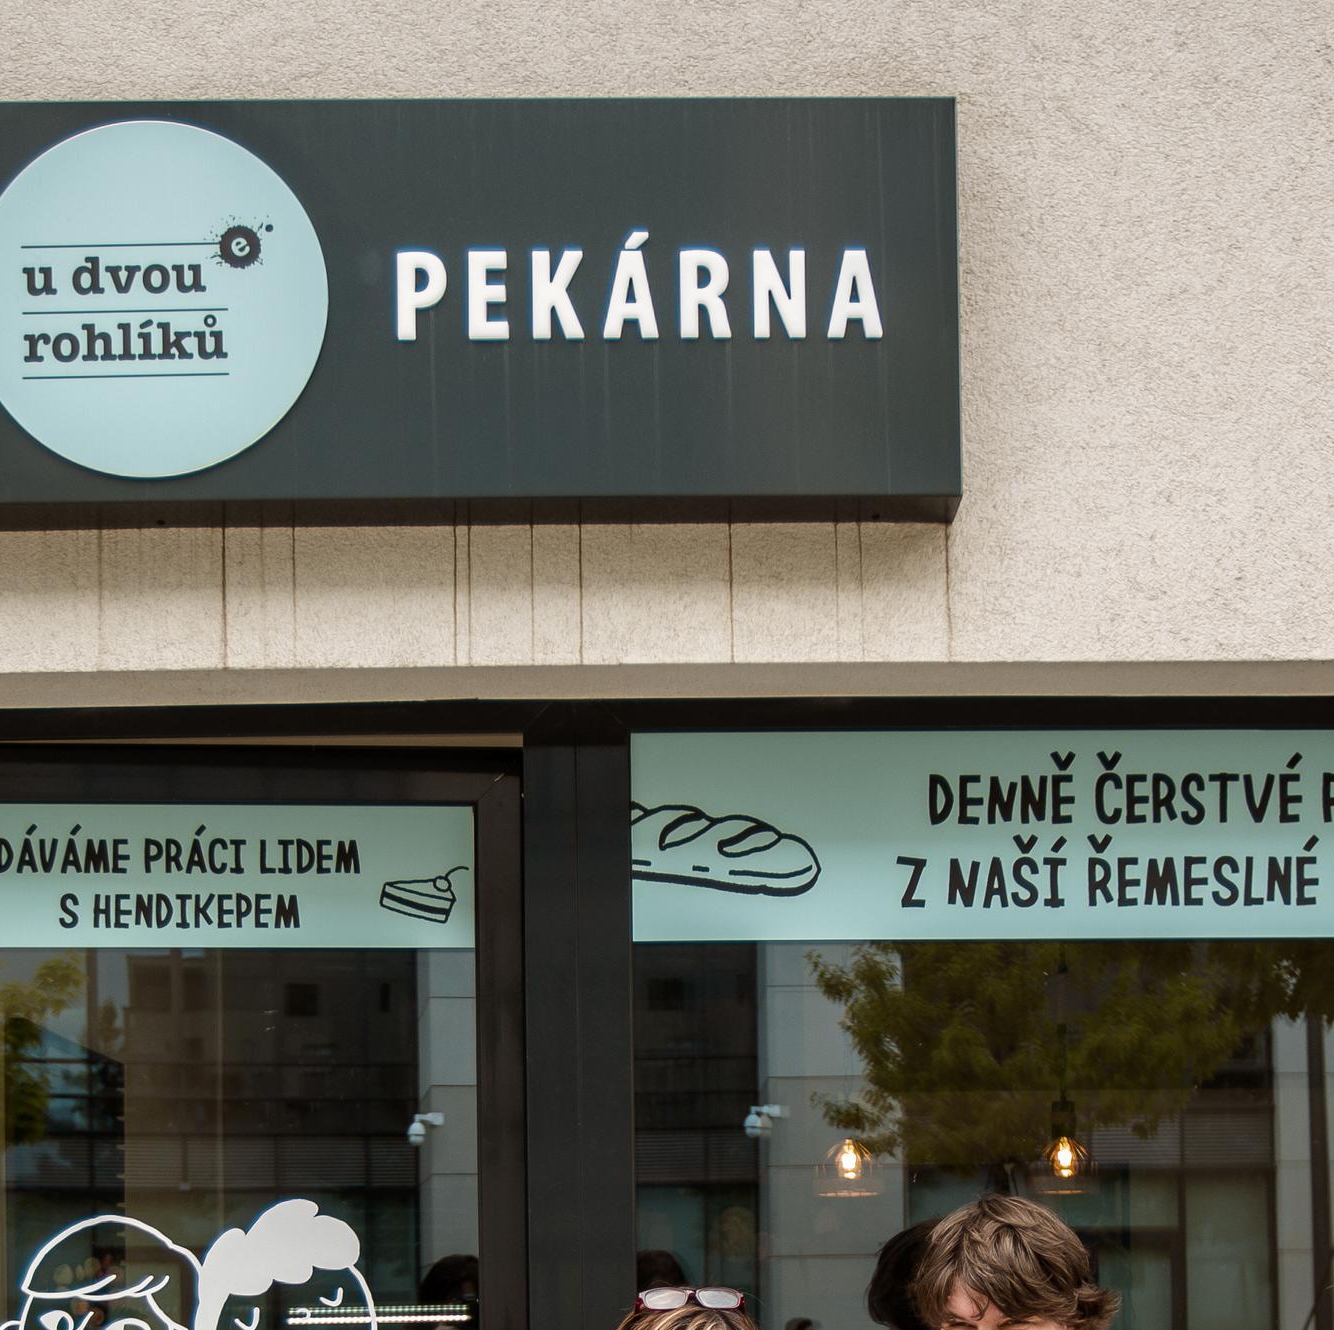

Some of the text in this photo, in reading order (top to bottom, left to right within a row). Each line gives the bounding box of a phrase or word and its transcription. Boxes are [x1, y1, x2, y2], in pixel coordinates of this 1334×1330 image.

[22, 256, 207, 297] u dvou
[396, 231, 884, 341] PEKÁRNA
[22, 313, 229, 363] rohlíků
[929, 751, 1075, 826] DENNĚ
[1095, 751, 1303, 826] ČERSTVÉ
[144, 824, 247, 875] PRÁCI
[259, 838, 361, 875] LIDEM
[896, 855, 928, 908] Z
[948, 834, 1068, 909] NAŠÍ
[1087, 834, 1320, 908] ŘEMESLNÉ
[59, 892, 301, 930] S HENDIKEPEM
